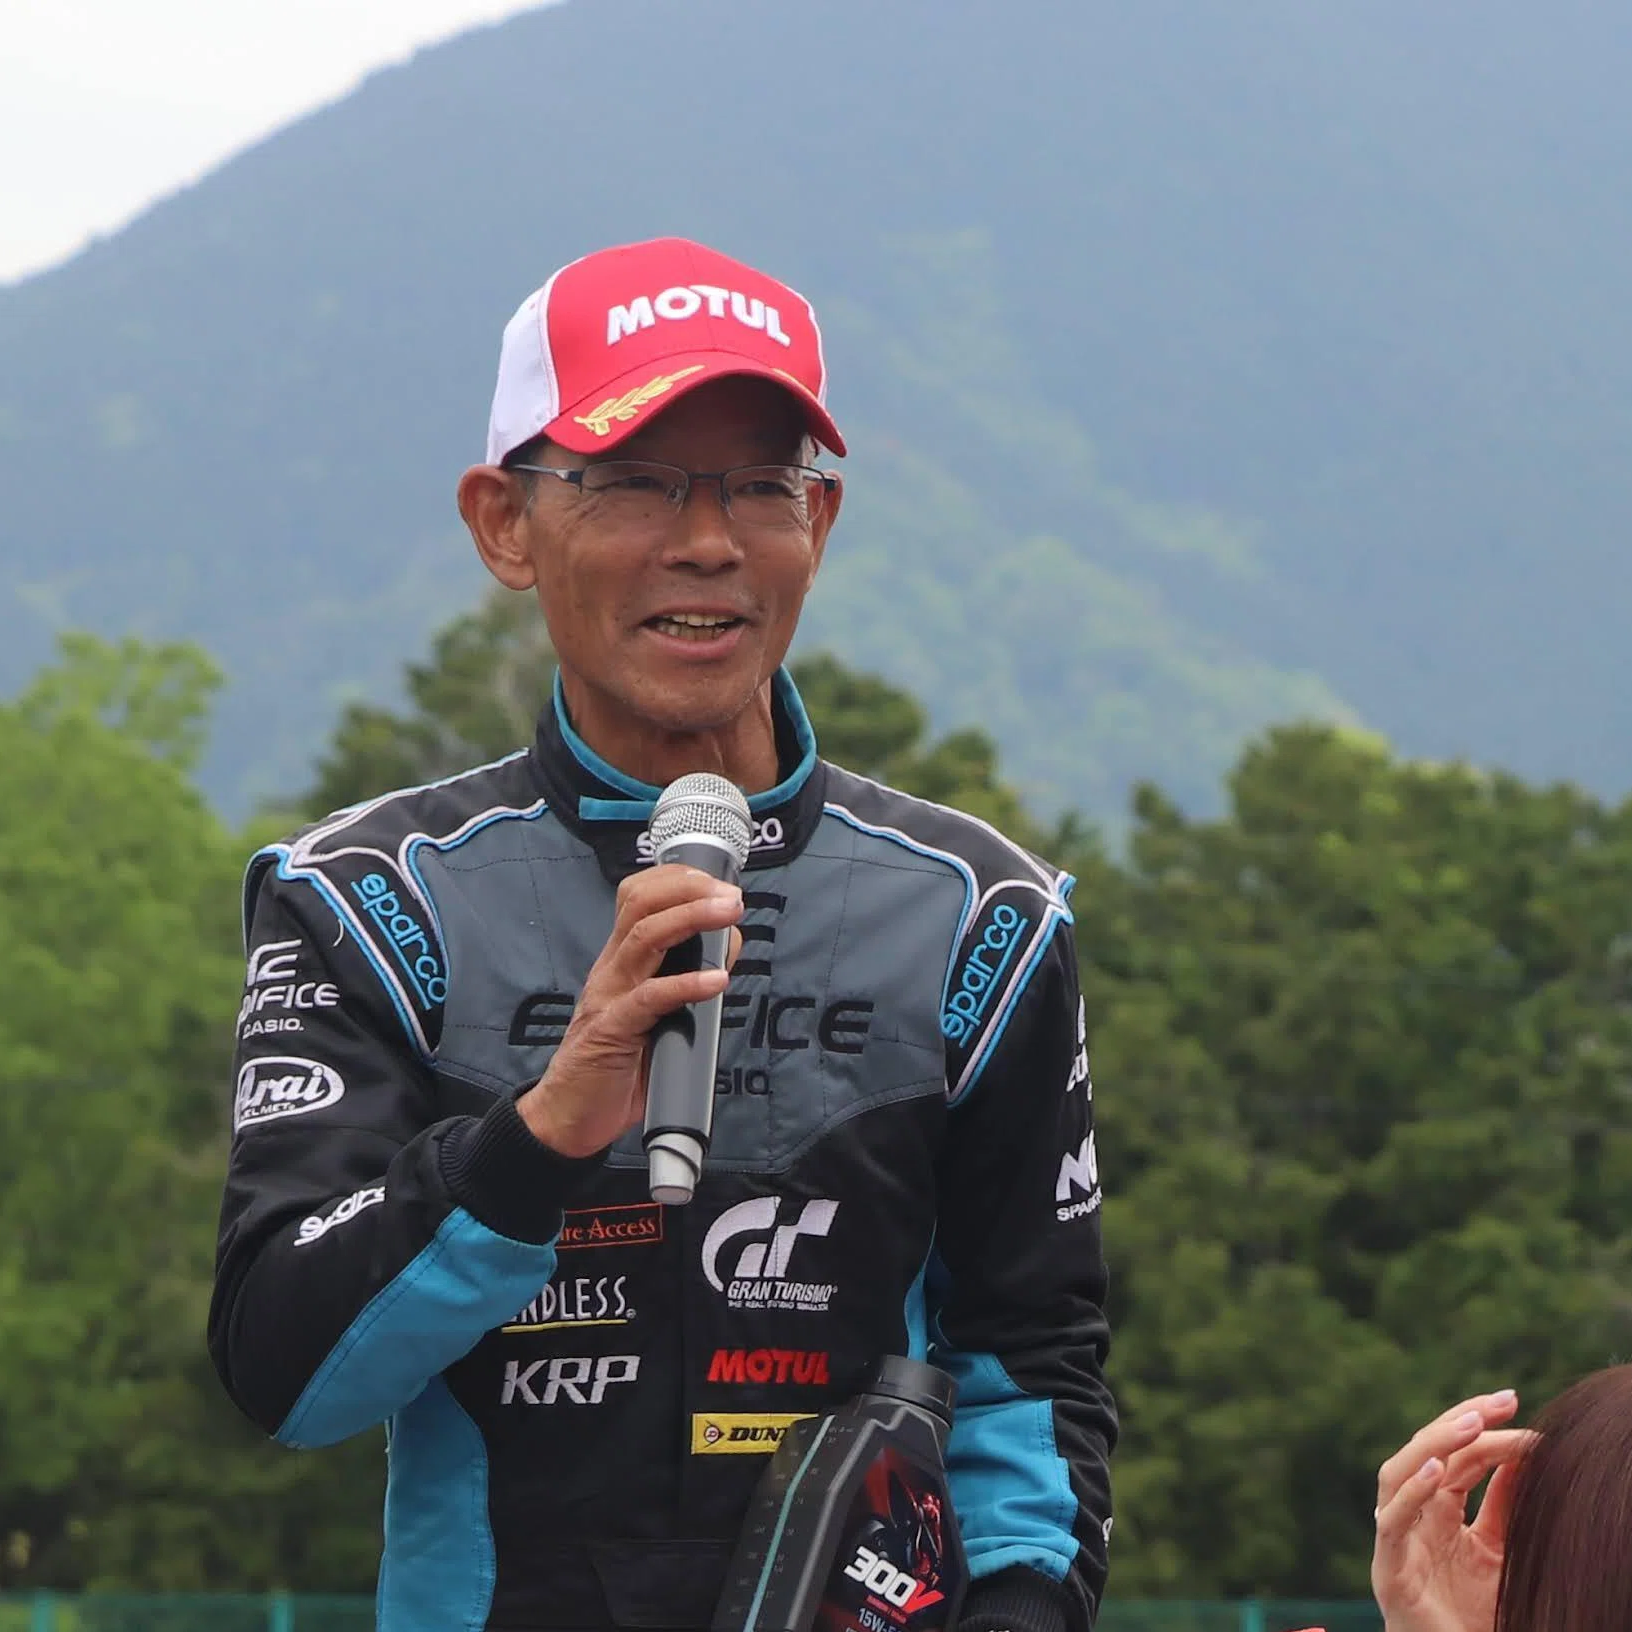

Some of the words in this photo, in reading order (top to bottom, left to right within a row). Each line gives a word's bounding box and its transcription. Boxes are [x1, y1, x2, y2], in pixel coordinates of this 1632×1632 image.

[607, 285, 791, 346] MOTUL
[588, 1216, 657, 1240] Access
[728, 1281, 772, 1300] GRAN
[774, 1282, 833, 1304] TURISMO
[500, 1355, 640, 1405] KRP
[707, 1348, 830, 1385] MOTUL
[844, 1546, 945, 1614] 300V
